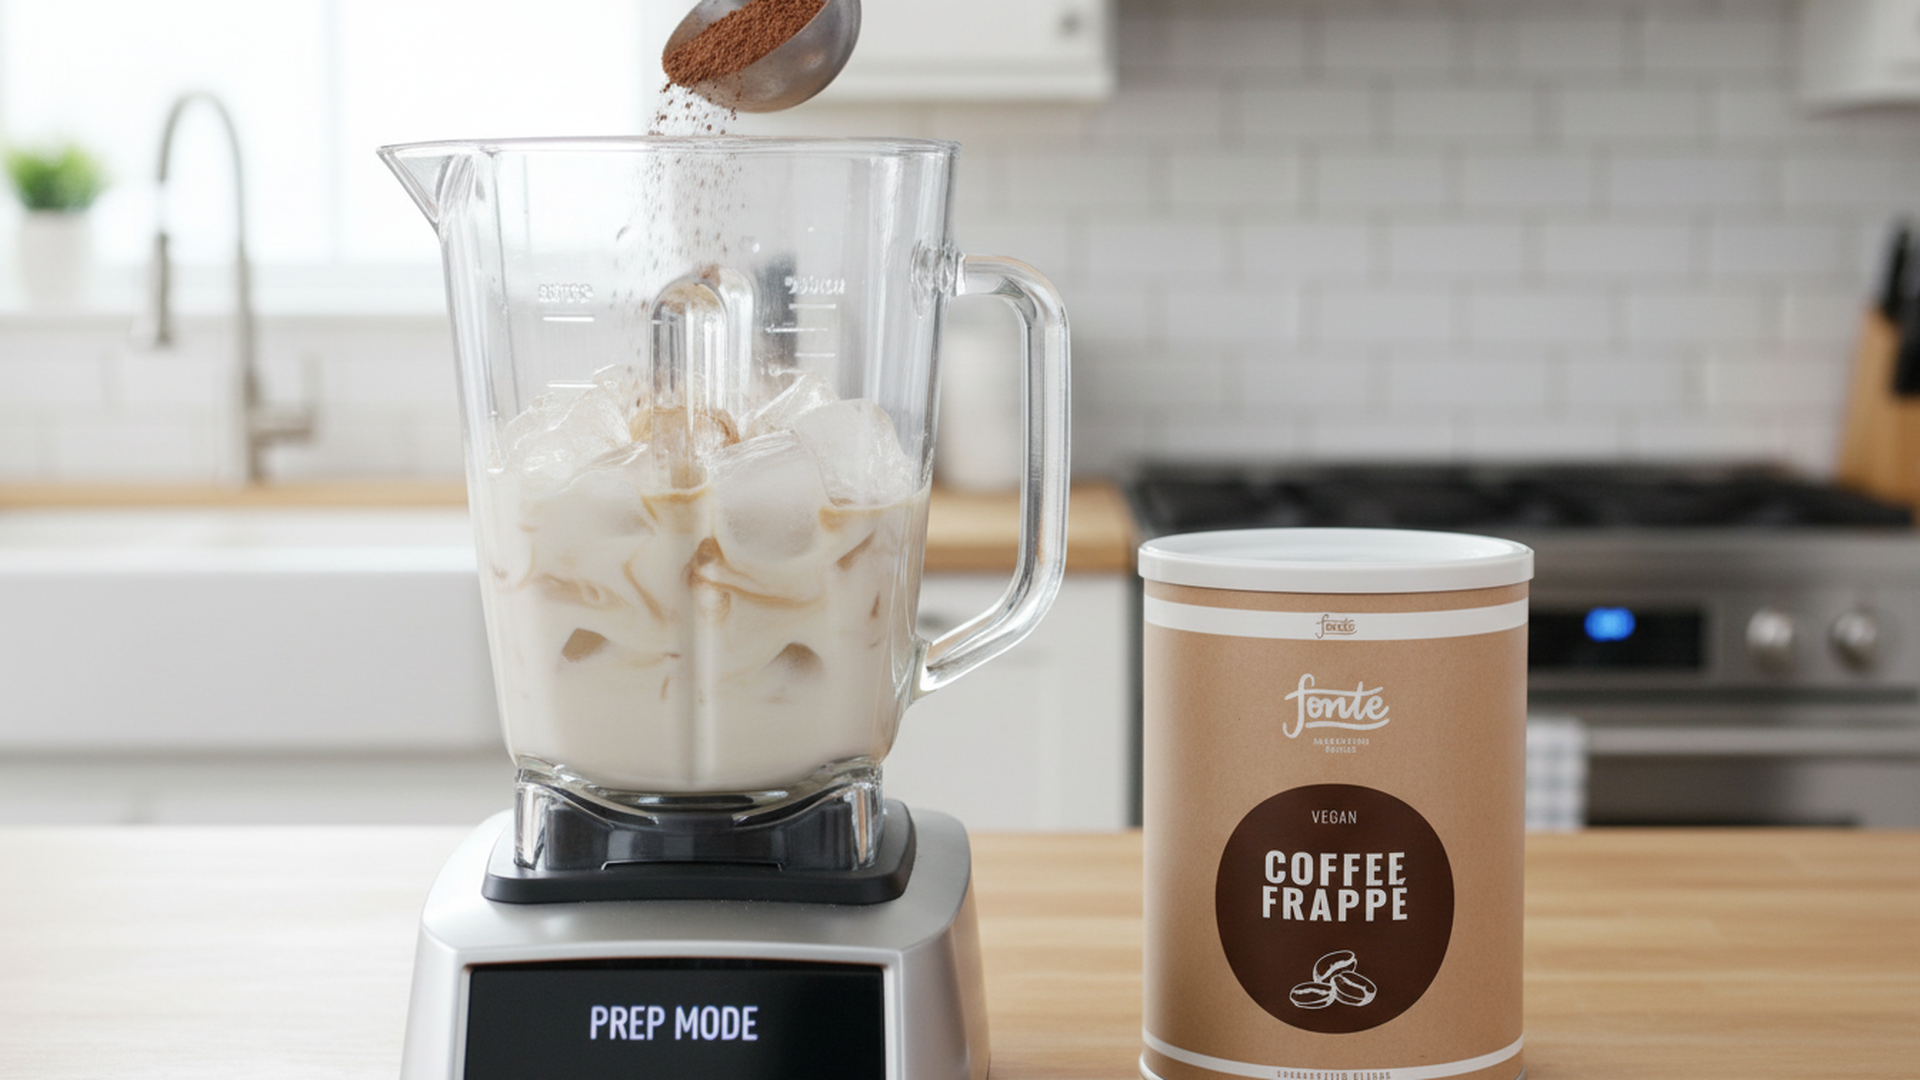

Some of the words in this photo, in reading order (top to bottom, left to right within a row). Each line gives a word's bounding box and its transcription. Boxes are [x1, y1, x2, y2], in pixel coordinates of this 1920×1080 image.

[1283, 673, 1390, 738] fonte
[1311, 810, 1357, 824] VEGAN
[1264, 850, 1406, 887] COFFEE
[590, 1005, 665, 1041] PREP
[675, 1005, 758, 1041] MODE
